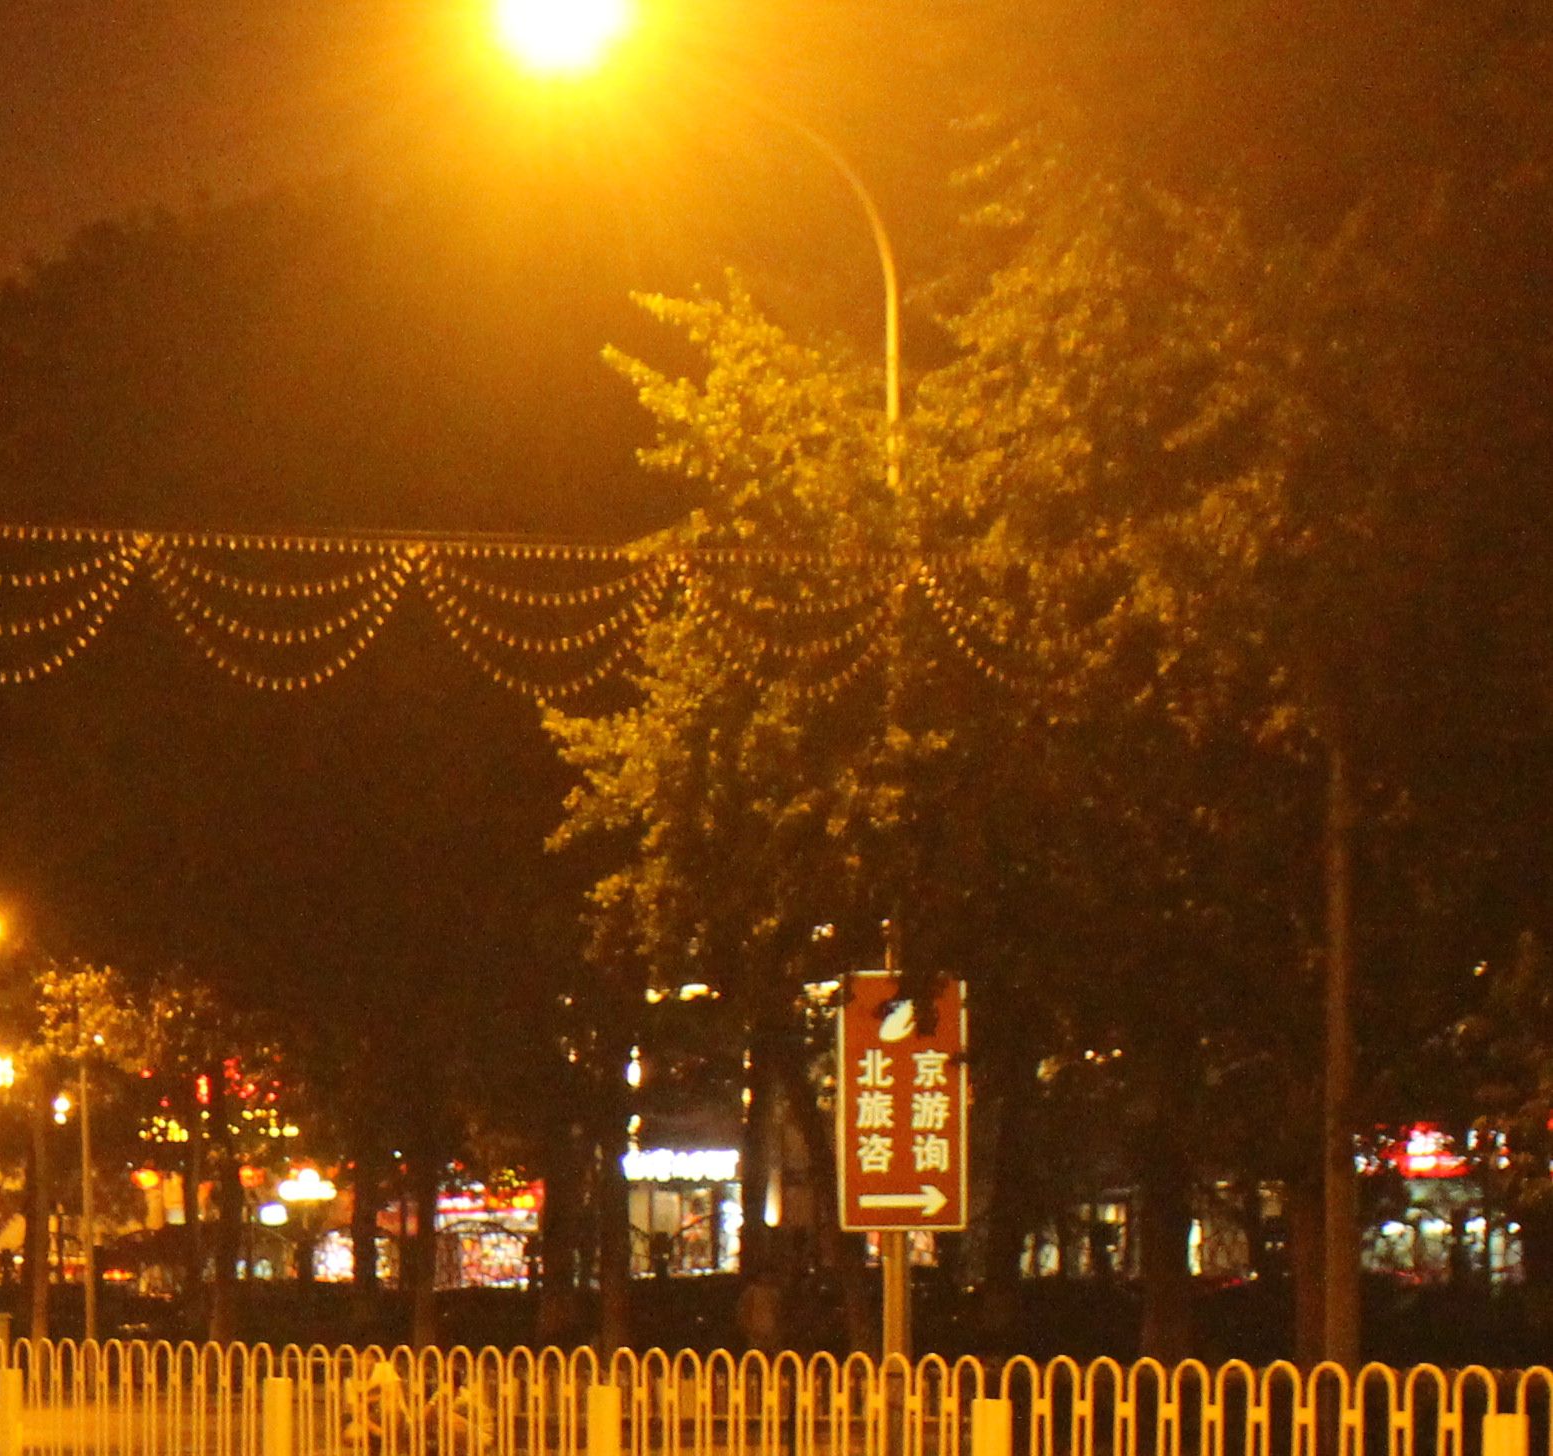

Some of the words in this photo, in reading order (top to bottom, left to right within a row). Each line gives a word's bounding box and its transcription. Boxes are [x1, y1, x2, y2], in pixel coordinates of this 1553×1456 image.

[856, 1049, 949, 1087] 北京
[856, 1091, 950, 1129] 旅游
[856, 1133, 950, 1173] 咨询
